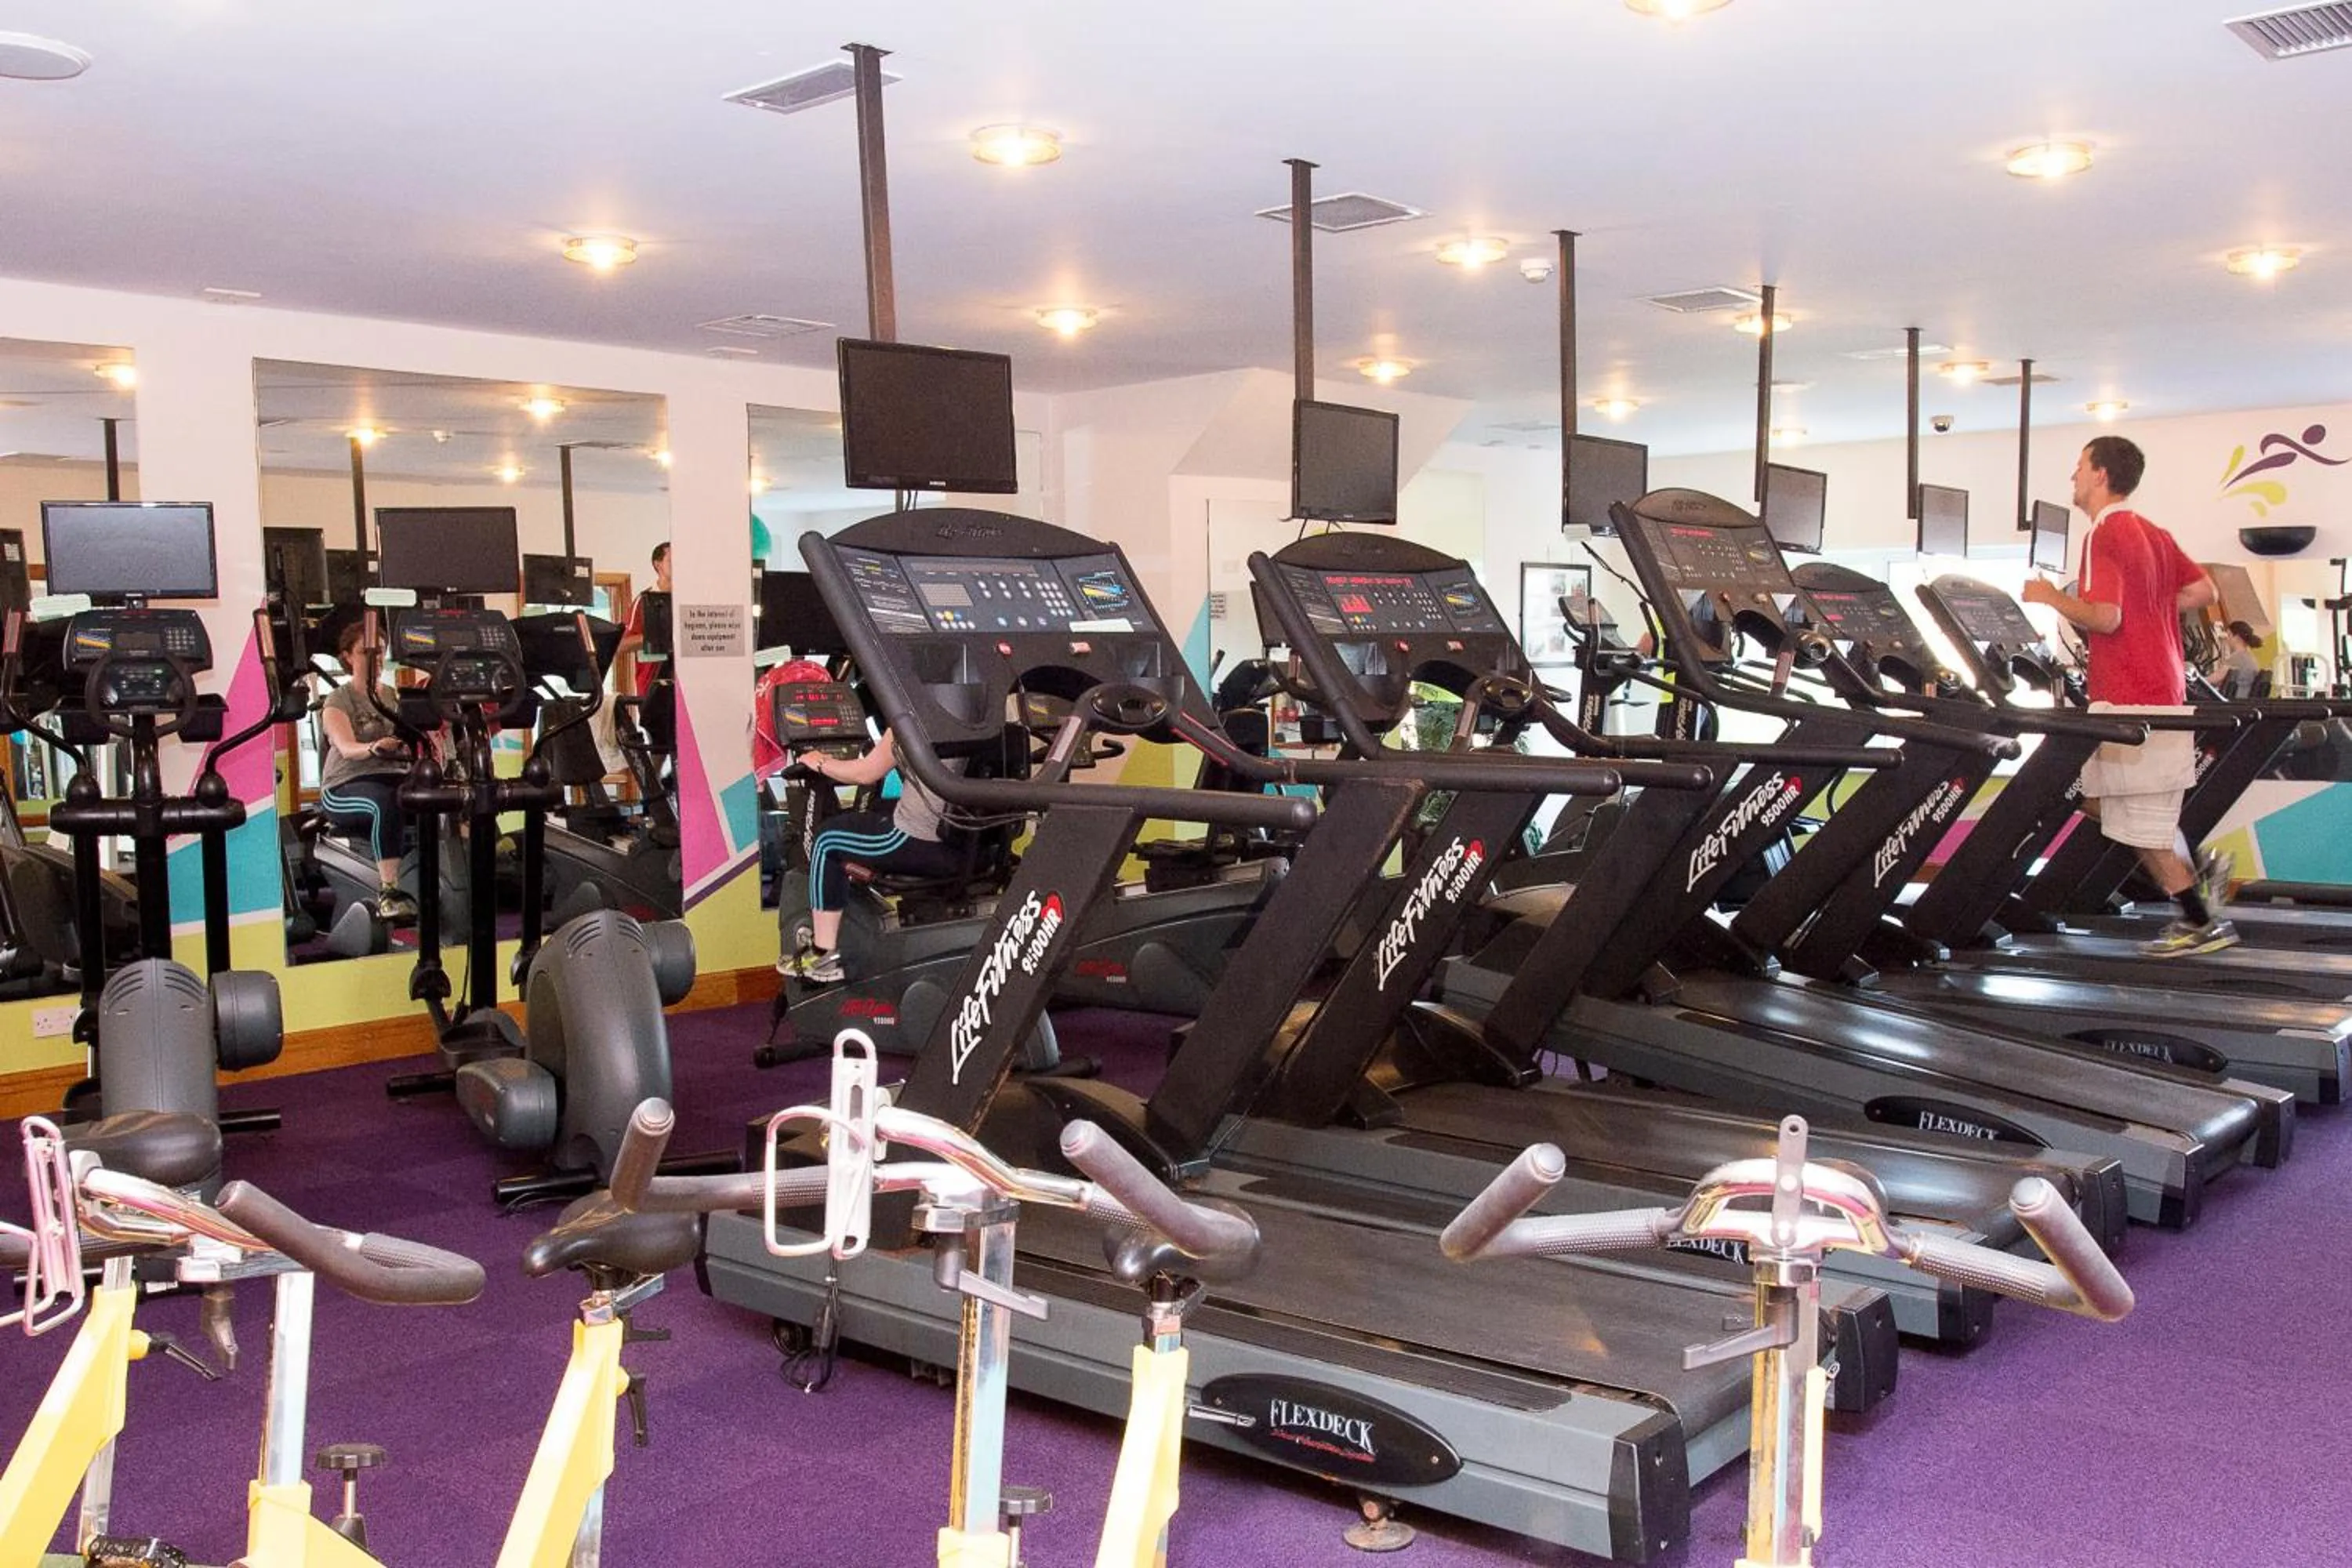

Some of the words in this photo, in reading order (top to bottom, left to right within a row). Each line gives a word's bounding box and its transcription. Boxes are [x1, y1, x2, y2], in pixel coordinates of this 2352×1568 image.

[1760, 786, 1800, 827] 9500HR
[1932, 786, 1963, 824] 9500HR
[1270, 1399, 1376, 1456] FLEXDECK
